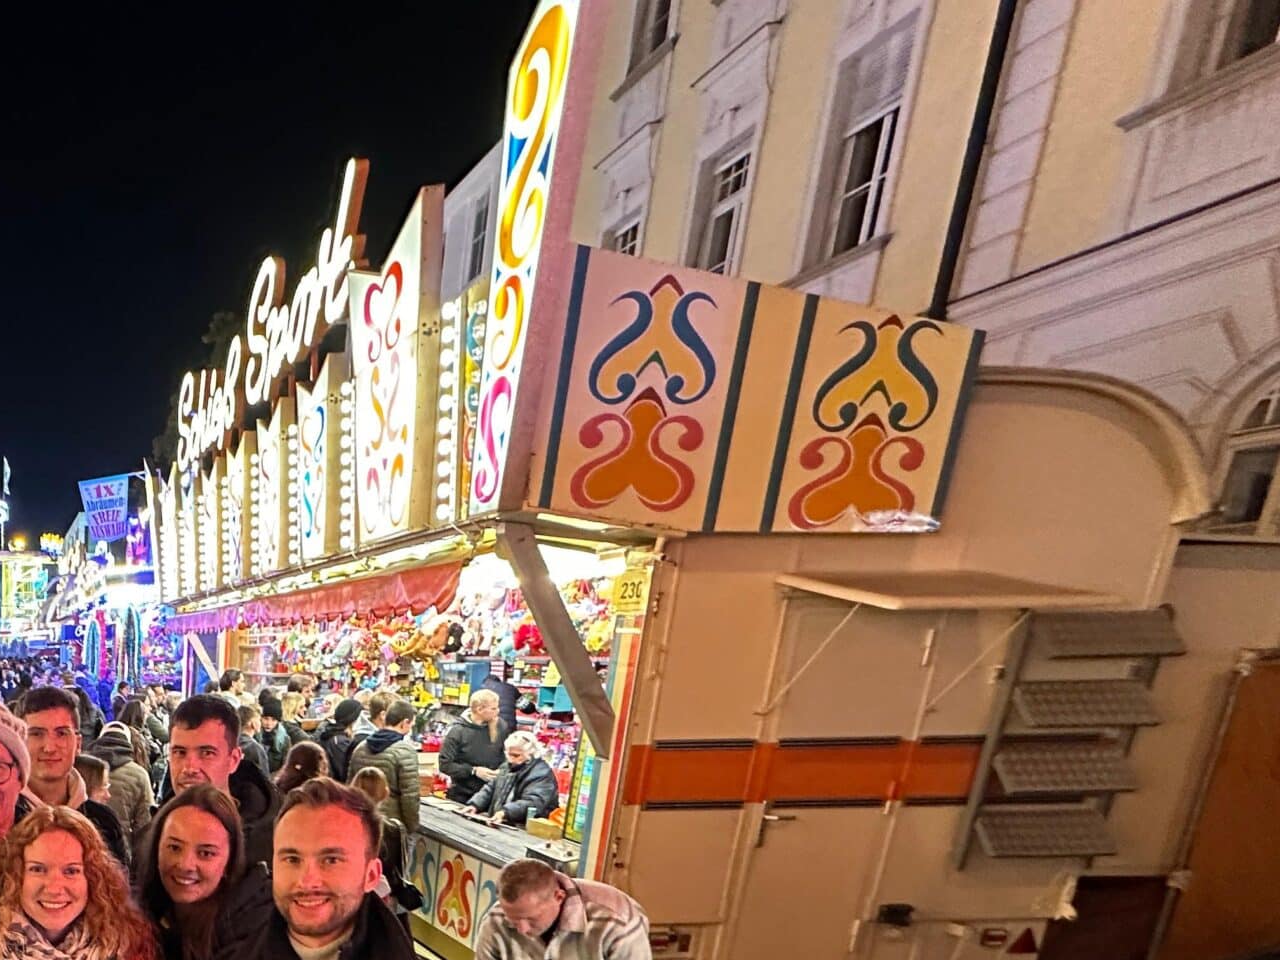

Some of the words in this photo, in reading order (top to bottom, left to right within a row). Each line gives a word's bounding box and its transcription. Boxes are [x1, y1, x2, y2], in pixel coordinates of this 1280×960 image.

[245, 156, 357, 405] Sport
[94, 484, 115, 499] 1x
[620, 581, 642, 600] 230
